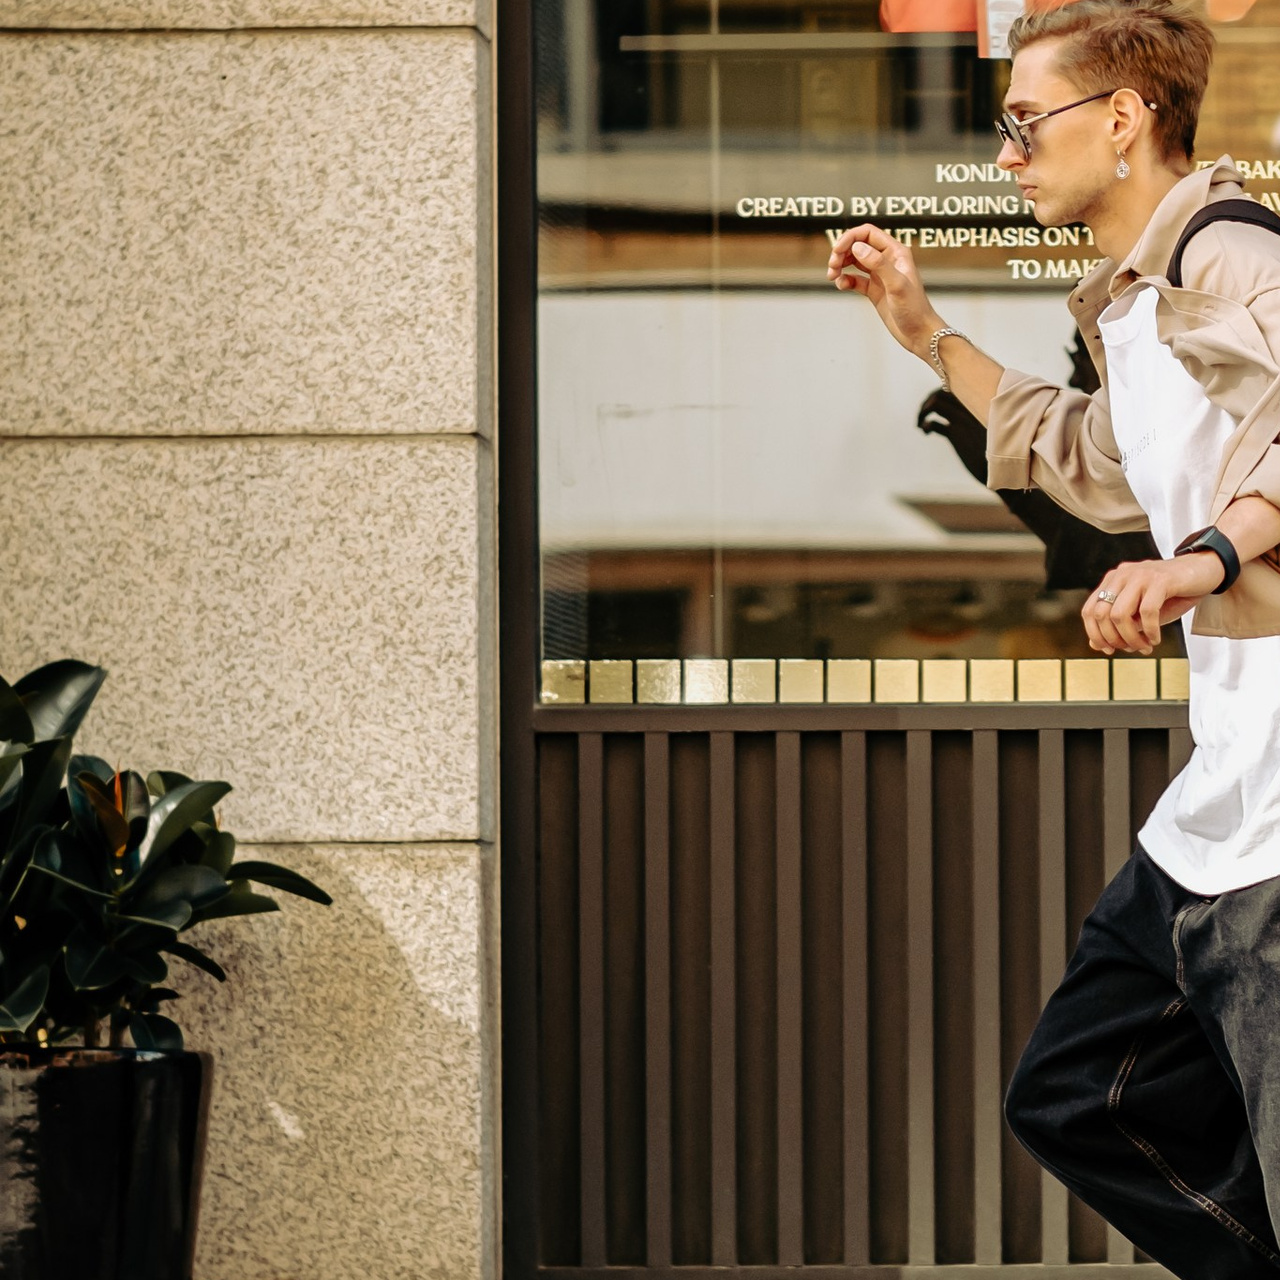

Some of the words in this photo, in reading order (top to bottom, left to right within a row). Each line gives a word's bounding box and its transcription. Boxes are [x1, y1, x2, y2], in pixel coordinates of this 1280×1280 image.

[736, 196, 844, 217] CREATED
[851, 196, 883, 216] BY
[885, 194, 1020, 216] EXPLORING
[918, 226, 1041, 248] EMPHASIS
[1042, 226, 1081, 247] ON
[1006, 259, 1041, 279] TO
